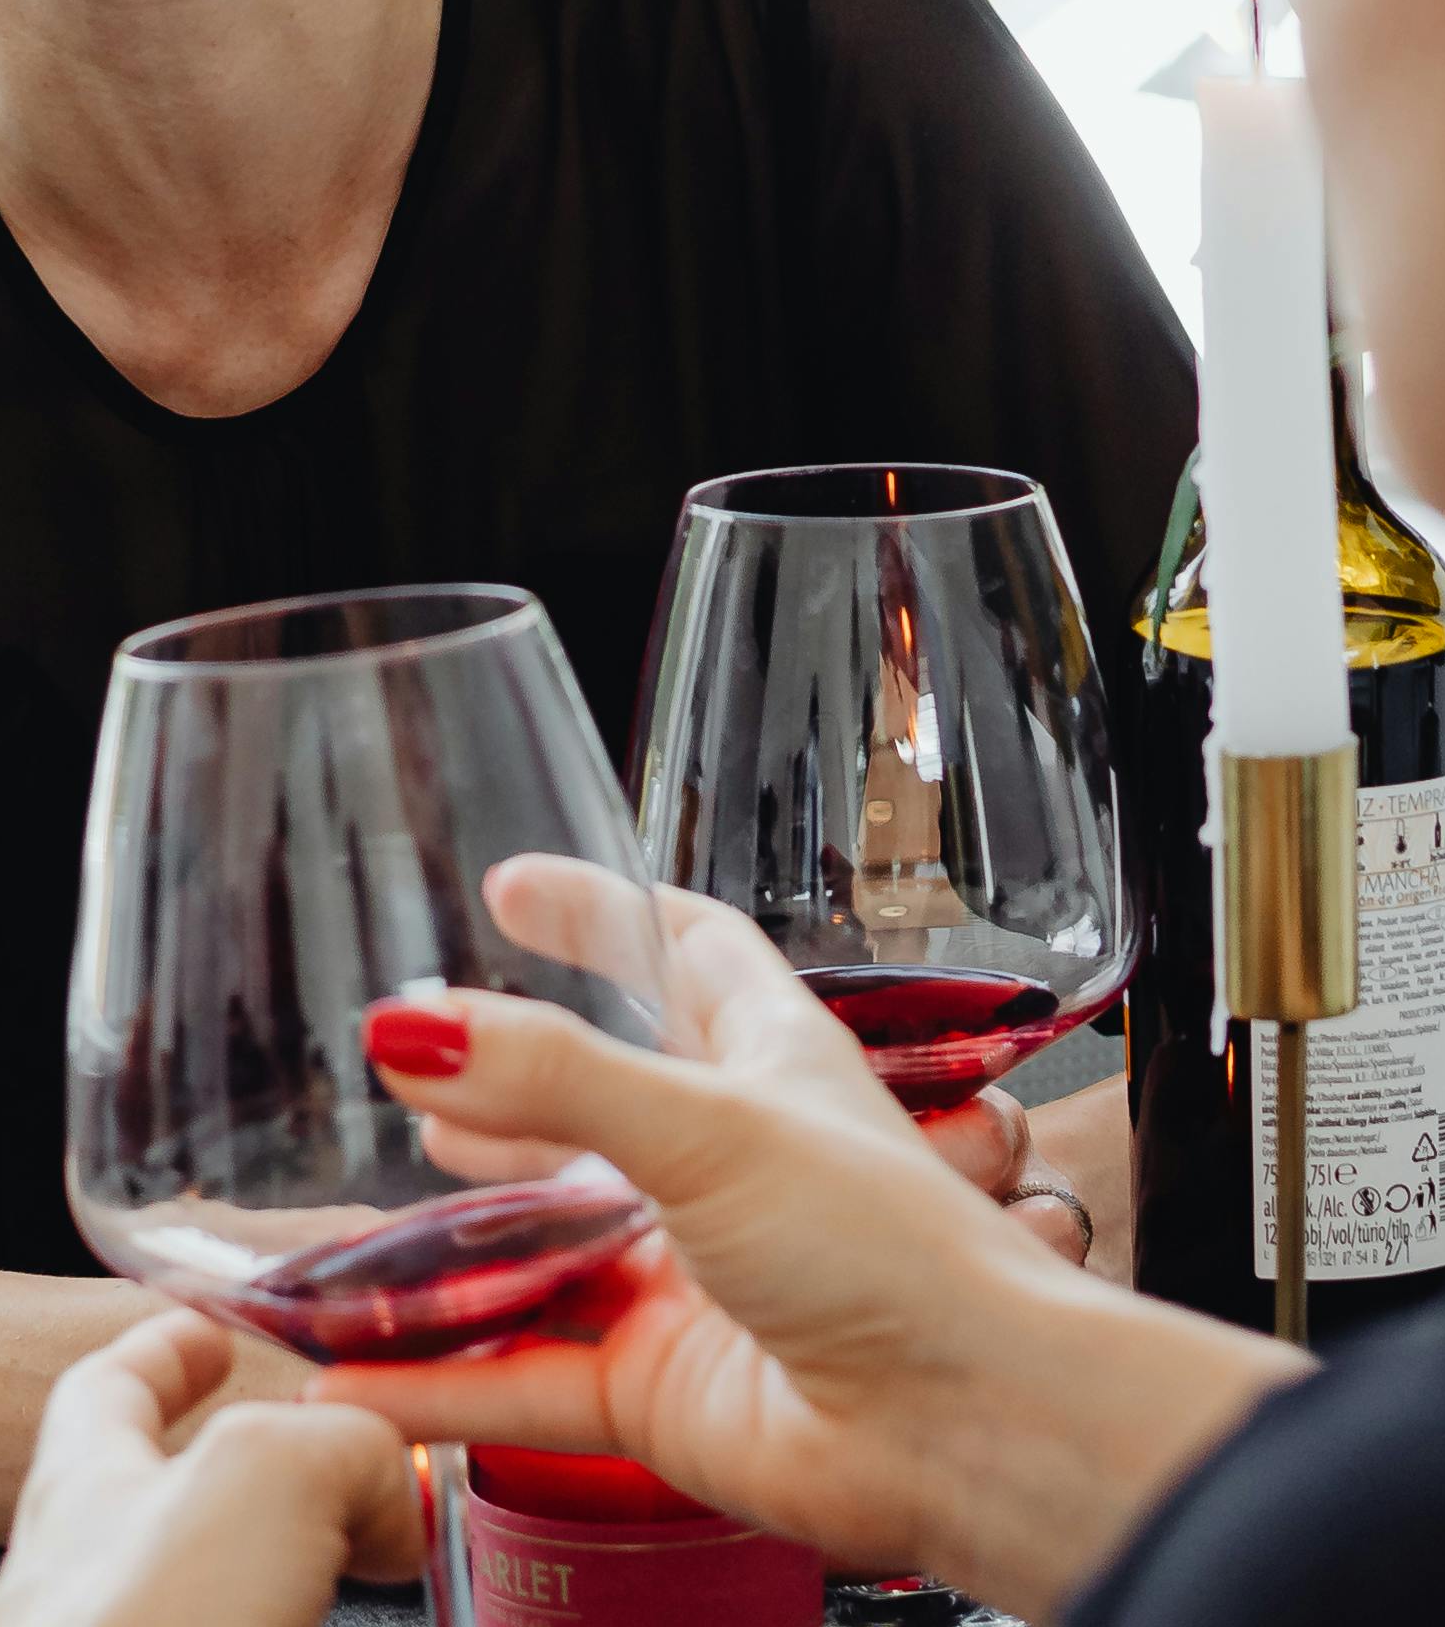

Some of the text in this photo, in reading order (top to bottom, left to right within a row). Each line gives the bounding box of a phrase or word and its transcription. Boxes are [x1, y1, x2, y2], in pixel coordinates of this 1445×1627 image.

[1356, 797, 1375, 817] IZ
[1364, 866, 1441, 894] MANCHA
[1377, 893, 1393, 906] de
[1396, 888, 1432, 906] Origen
[1263, 1163, 1278, 1186] 75
[1305, 1194, 1348, 1222] k./Alc.
[1264, 1223, 1278, 1246] 12
[477, 1549, 575, 1606] ARLET
